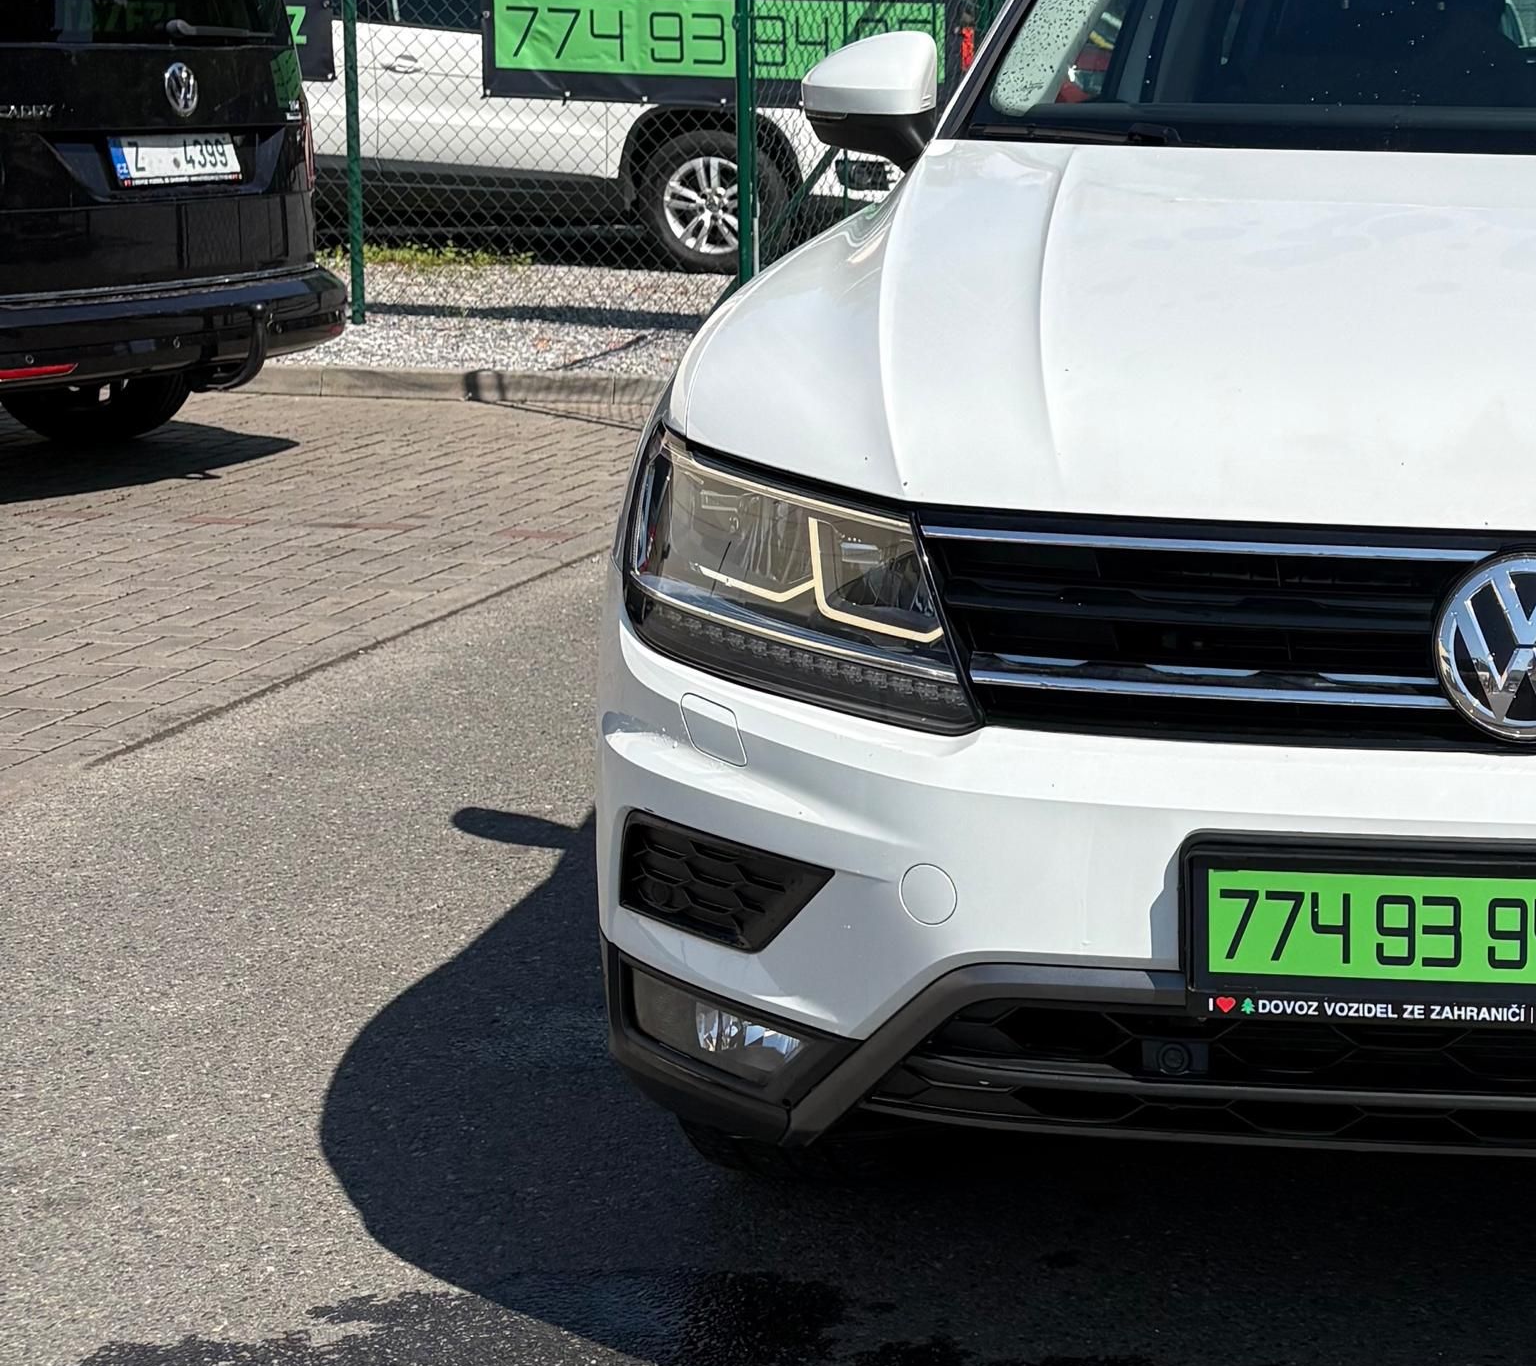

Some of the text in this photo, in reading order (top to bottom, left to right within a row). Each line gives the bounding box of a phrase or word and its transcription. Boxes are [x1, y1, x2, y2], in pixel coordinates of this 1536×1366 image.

[505, 6, 624, 62] 774
[648, 12, 724, 65] 93
[183, 138, 228, 169] 4399
[1219, 888, 1351, 965] 774
[1375, 894, 1463, 968] 93
[1257, 999, 1319, 1017] DOVOZ
[1323, 1000, 1398, 1019] VOZIDEL
[1402, 1004, 1425, 1020] ZE
[1429, 1003, 1526, 1023] ZAHRANIČÍ
